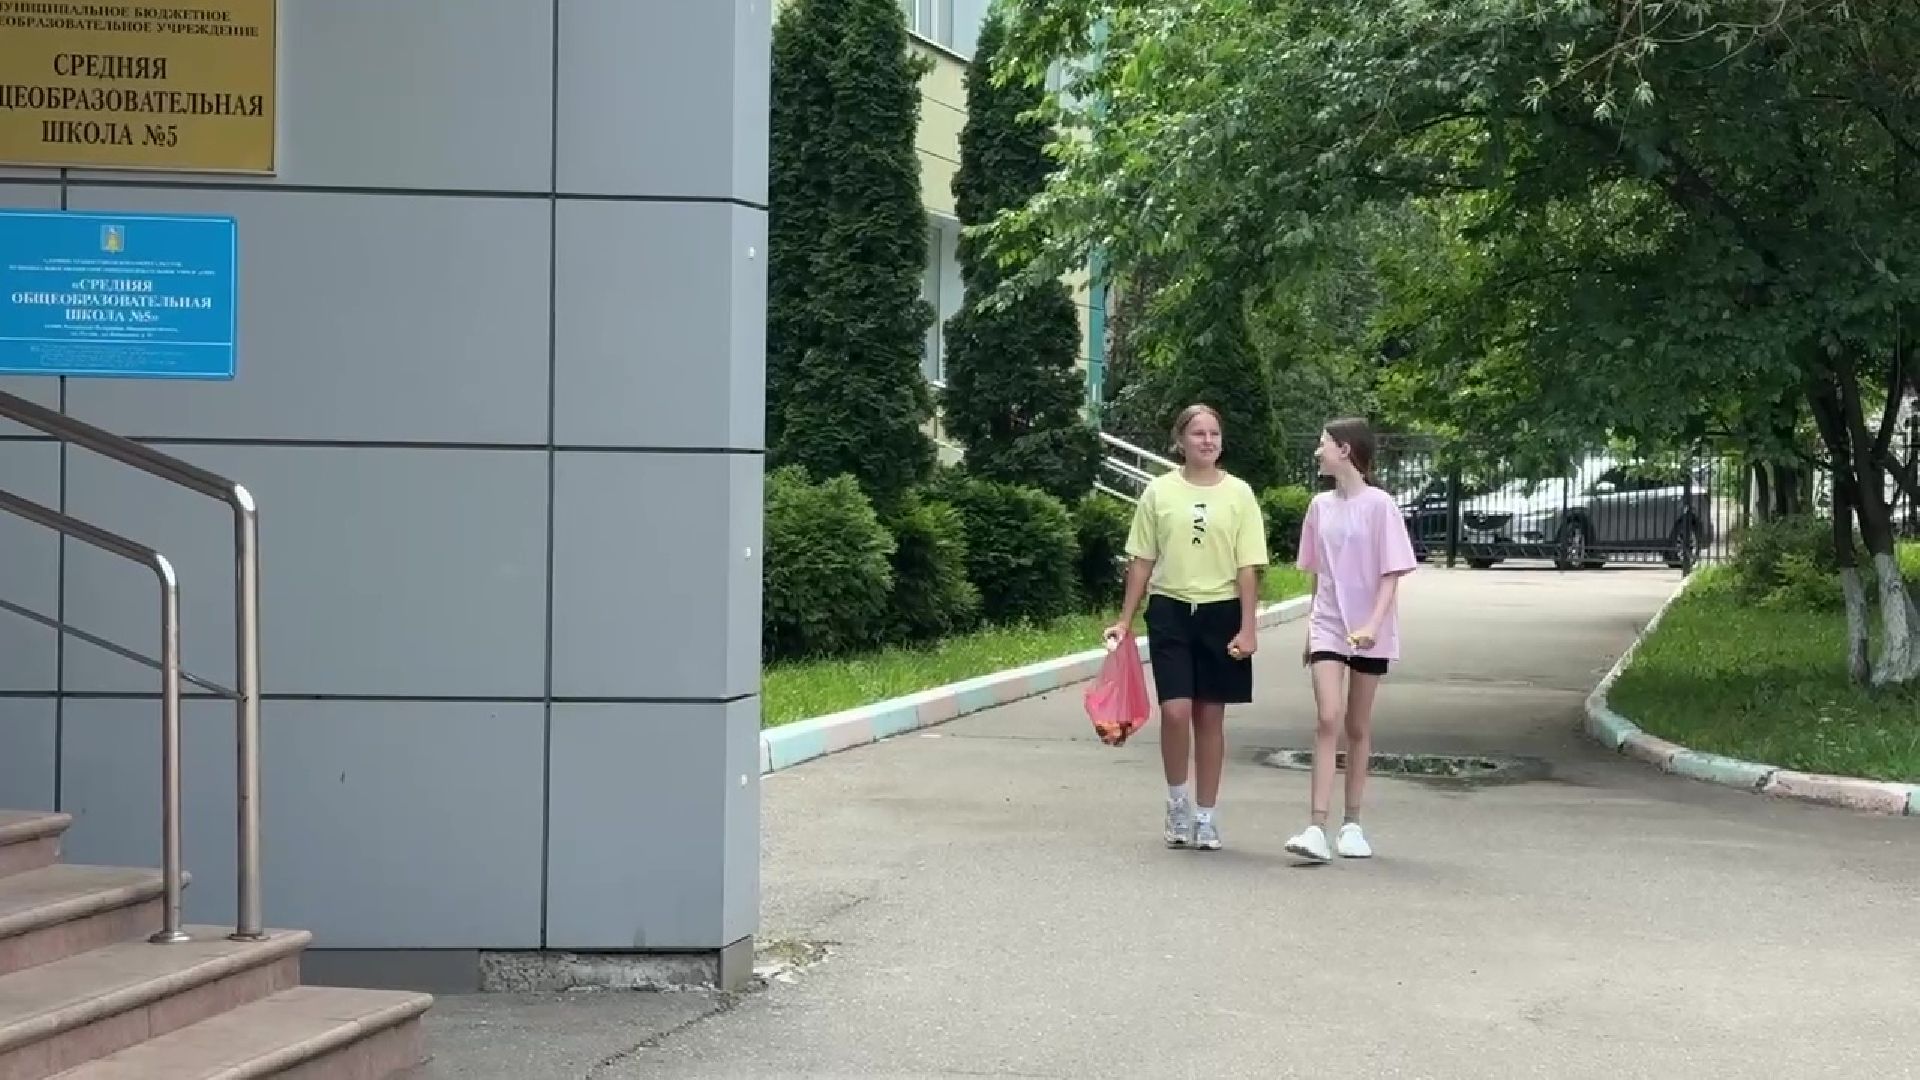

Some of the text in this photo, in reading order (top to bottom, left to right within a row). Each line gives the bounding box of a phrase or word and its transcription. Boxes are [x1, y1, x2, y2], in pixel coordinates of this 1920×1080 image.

[134, 7, 231, 22] БЮДЖЕТНОЕ
[156, 23, 259, 37] УЧРЕЖДЕНИЕ
[53, 53, 167, 80] СРЕДНЯЯ
[42, 120, 178, 147] ШКОЛА №5
[11, 291, 212, 309] ОБЩЕОБРАЗОВАТЕЛЬНАЯ
[65, 308, 124, 322] ШКОЛА
